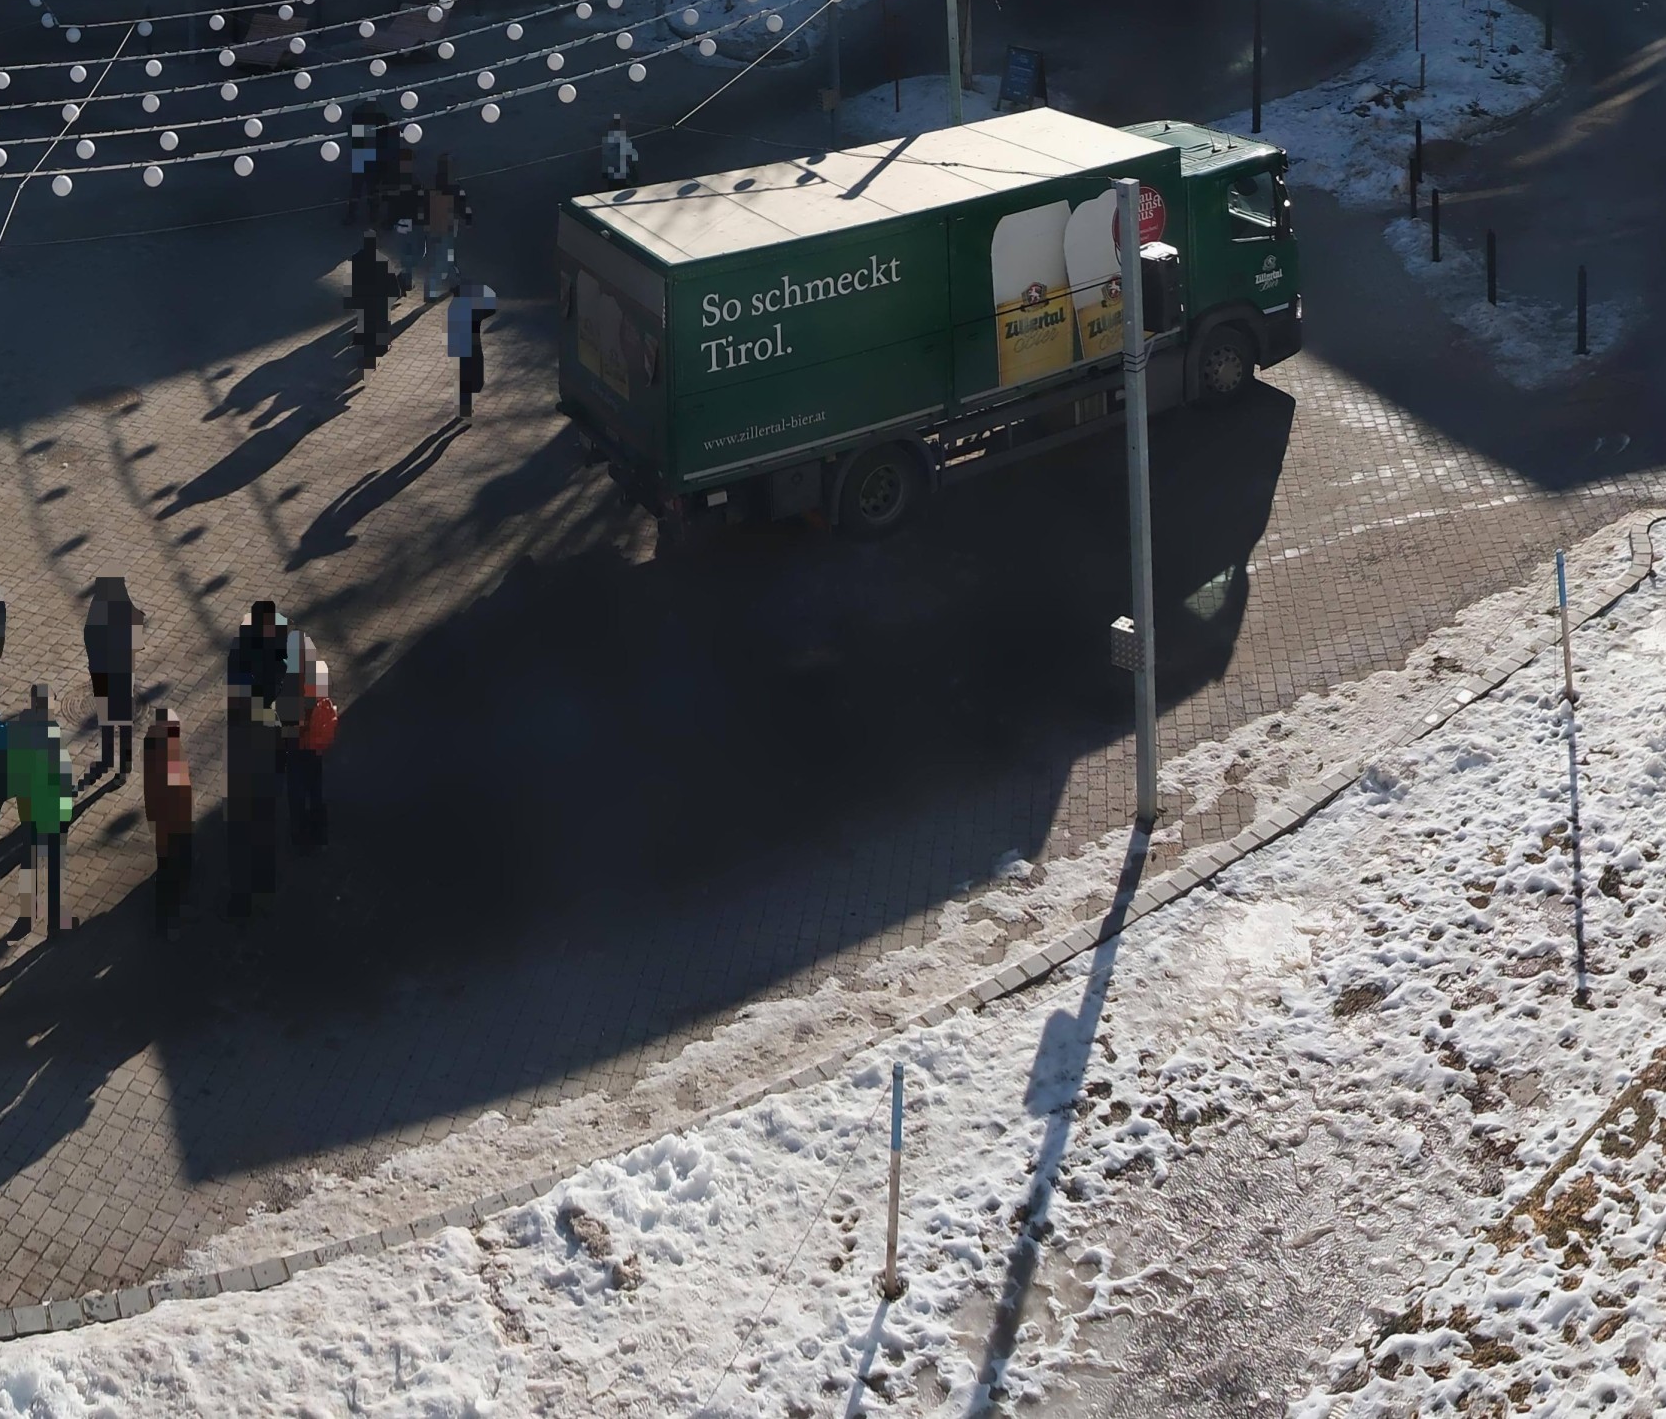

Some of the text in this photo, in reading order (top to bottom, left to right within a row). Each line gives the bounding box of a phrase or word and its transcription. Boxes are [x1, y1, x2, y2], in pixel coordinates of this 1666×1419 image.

[1138, 194, 1162, 213] unst
[1139, 192, 1153, 203] au
[702, 255, 902, 327] So schmeckt
[1005, 307, 1067, 339] Zillertal
[1087, 309, 1124, 339] Zille
[701, 323, 793, 373] Tirol.
[703, 409, 826, 451] www.zillertal-bier.at
